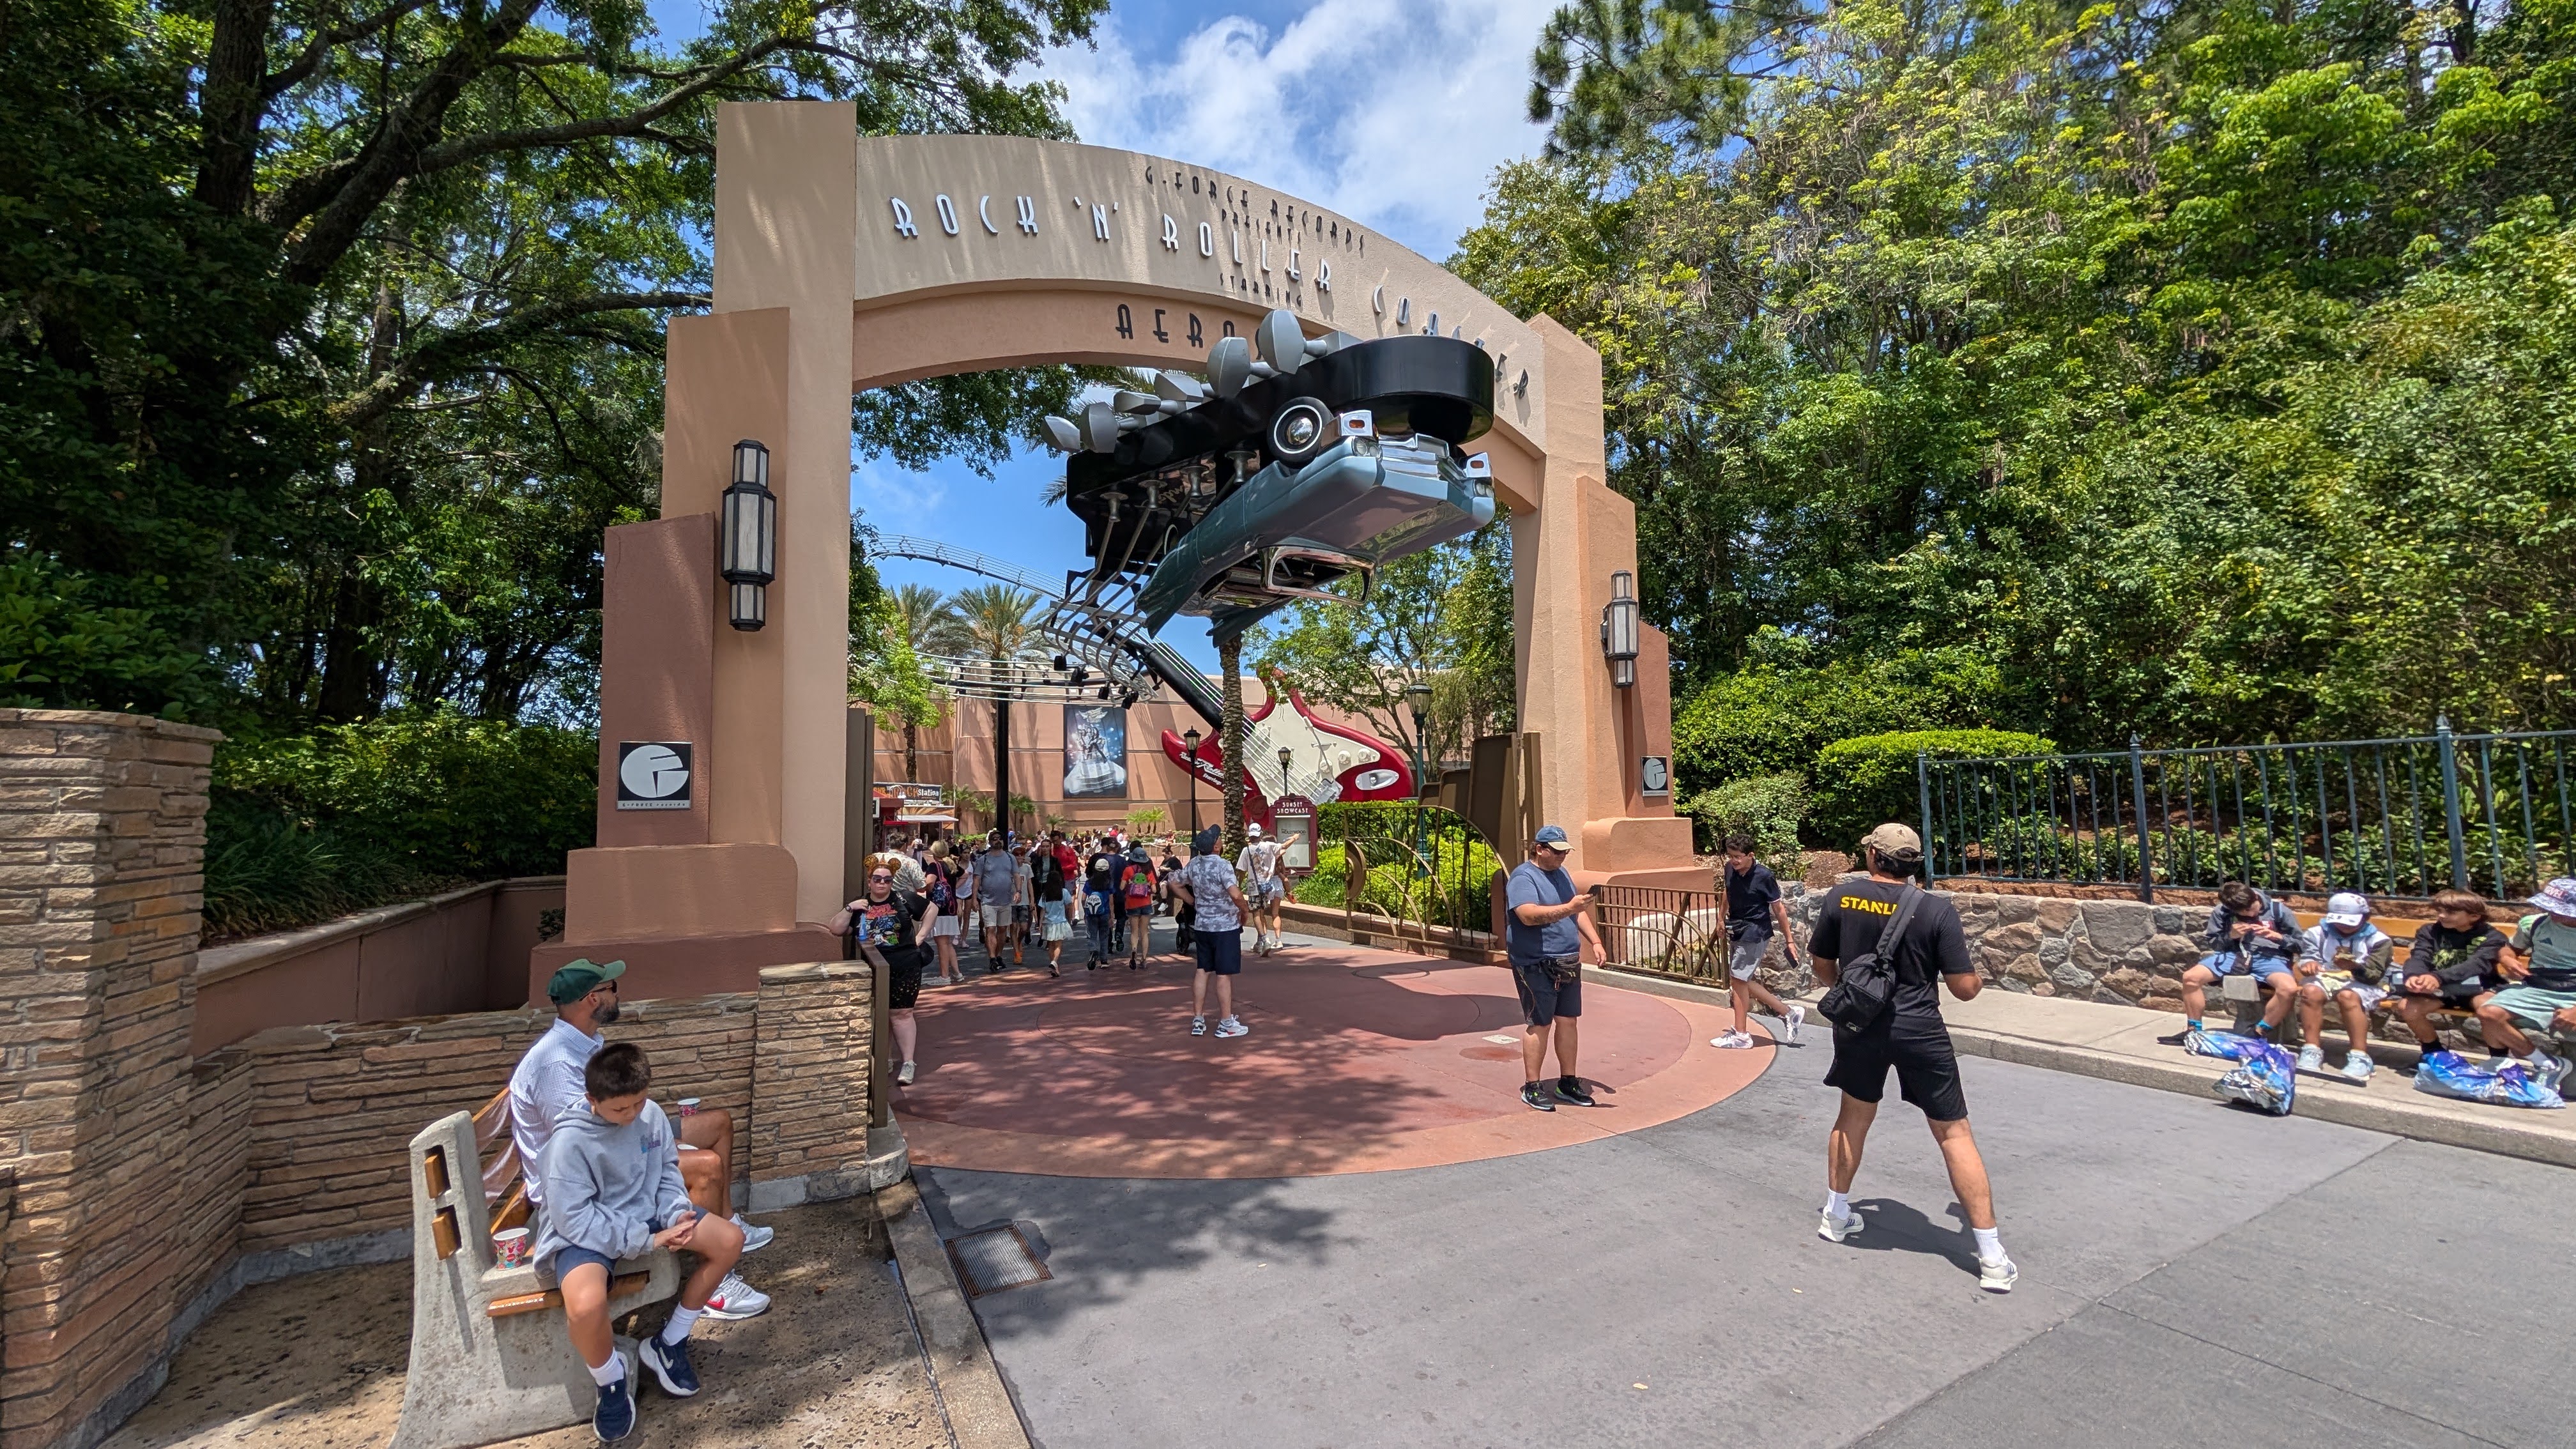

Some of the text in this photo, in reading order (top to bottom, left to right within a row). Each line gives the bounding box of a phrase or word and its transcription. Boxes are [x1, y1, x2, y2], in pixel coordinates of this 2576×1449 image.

[889, 194, 1039, 240] ROCK
[1160, 213, 1331, 294] ROLLER
[1222, 208, 1301, 245] PRESENTS
[1270, 199, 1364, 250] RECORDS
[1220, 273, 1301, 307] STARRING
